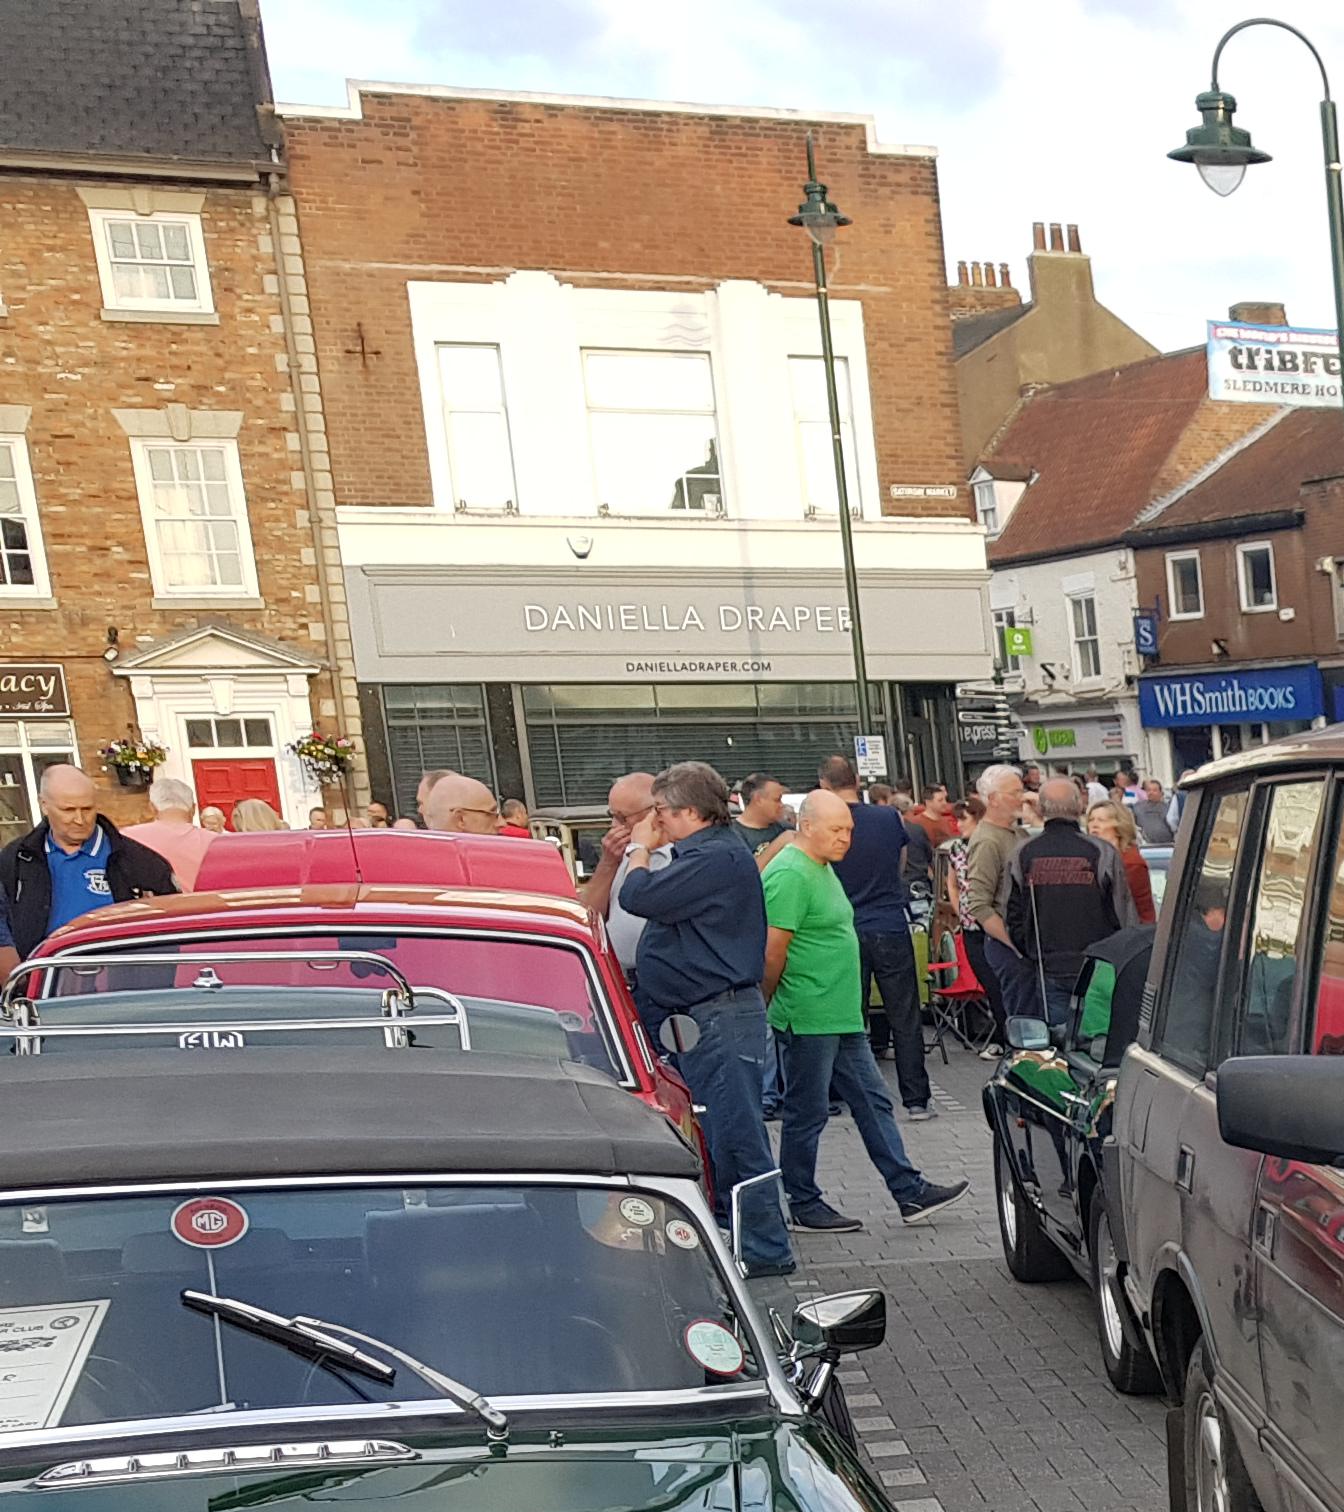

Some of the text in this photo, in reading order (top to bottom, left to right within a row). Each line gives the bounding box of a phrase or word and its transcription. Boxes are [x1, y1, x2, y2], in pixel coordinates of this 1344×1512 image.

[1225, 379, 1310, 396] SLEDMERE
[524, 604, 706, 632] DANIELLA
[626, 661, 772, 673] DANIELLADRAPER.COM
[197, 1212, 224, 1231] MG
